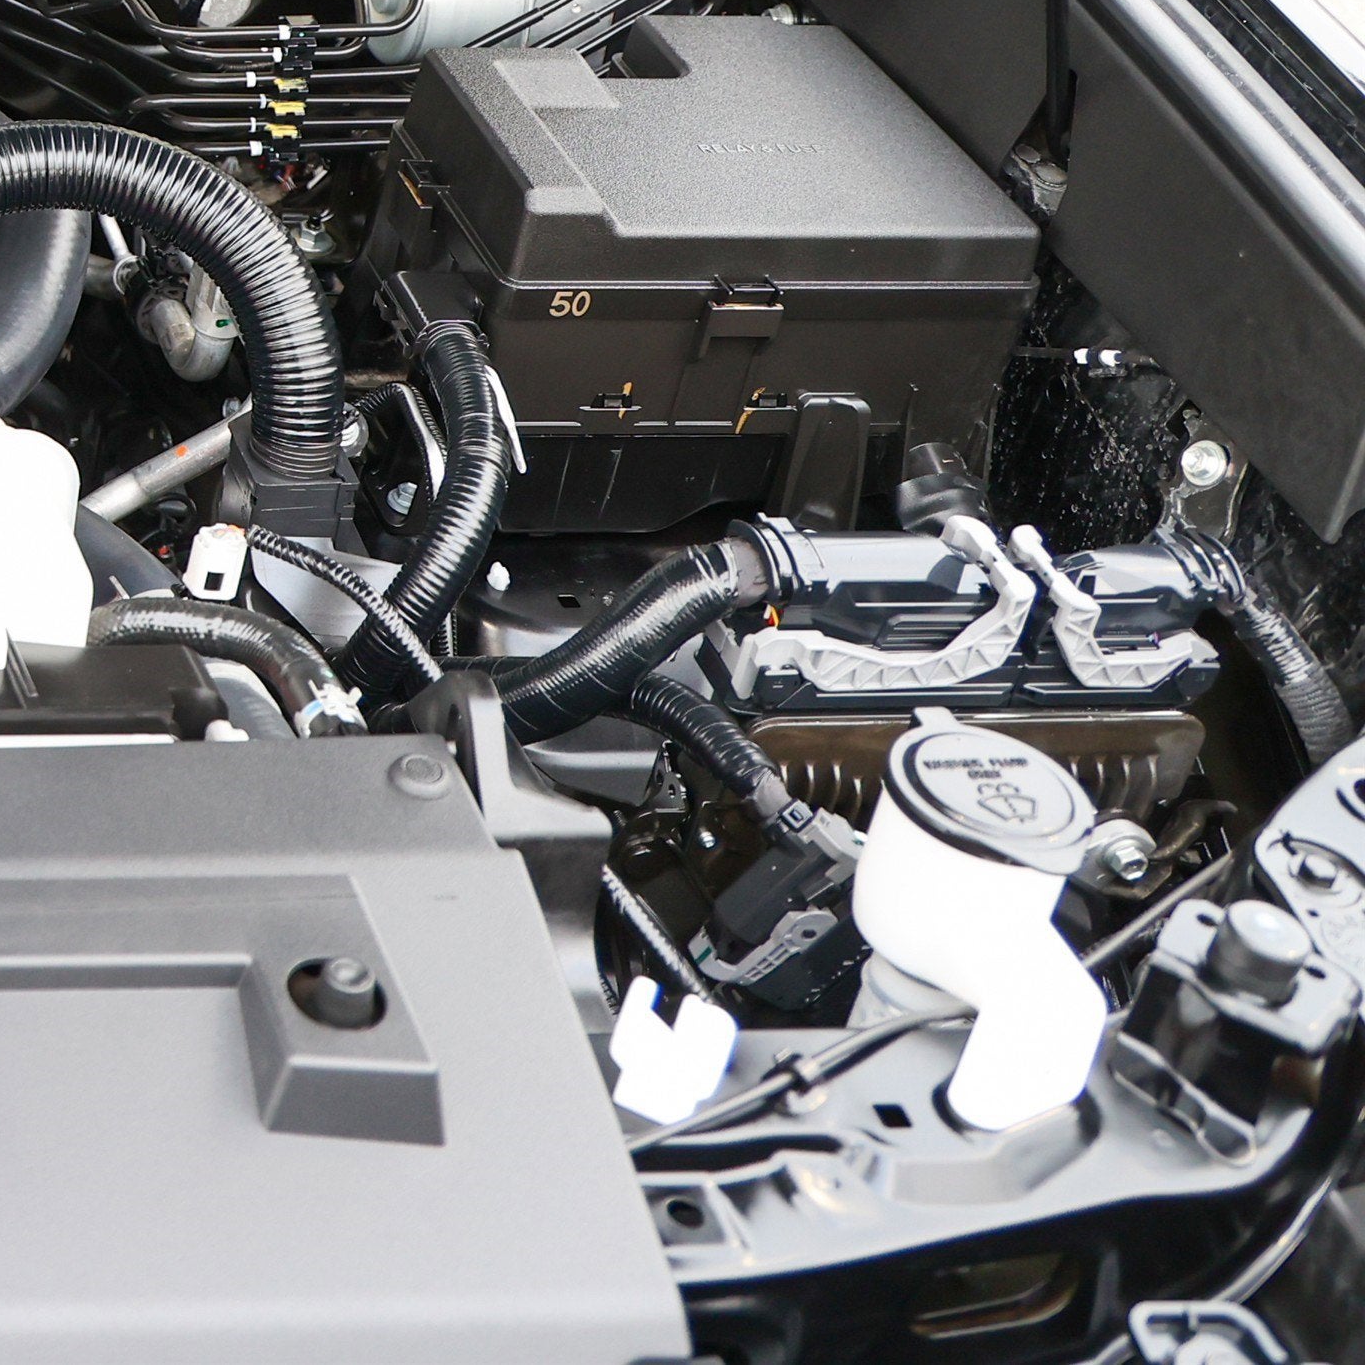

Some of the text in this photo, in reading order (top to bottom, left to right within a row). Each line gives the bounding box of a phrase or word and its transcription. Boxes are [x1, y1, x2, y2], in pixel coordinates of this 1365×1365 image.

[697, 143, 757, 154] RELAY
[776, 143, 825, 154] FUSE
[548, 290, 592, 318] 50
